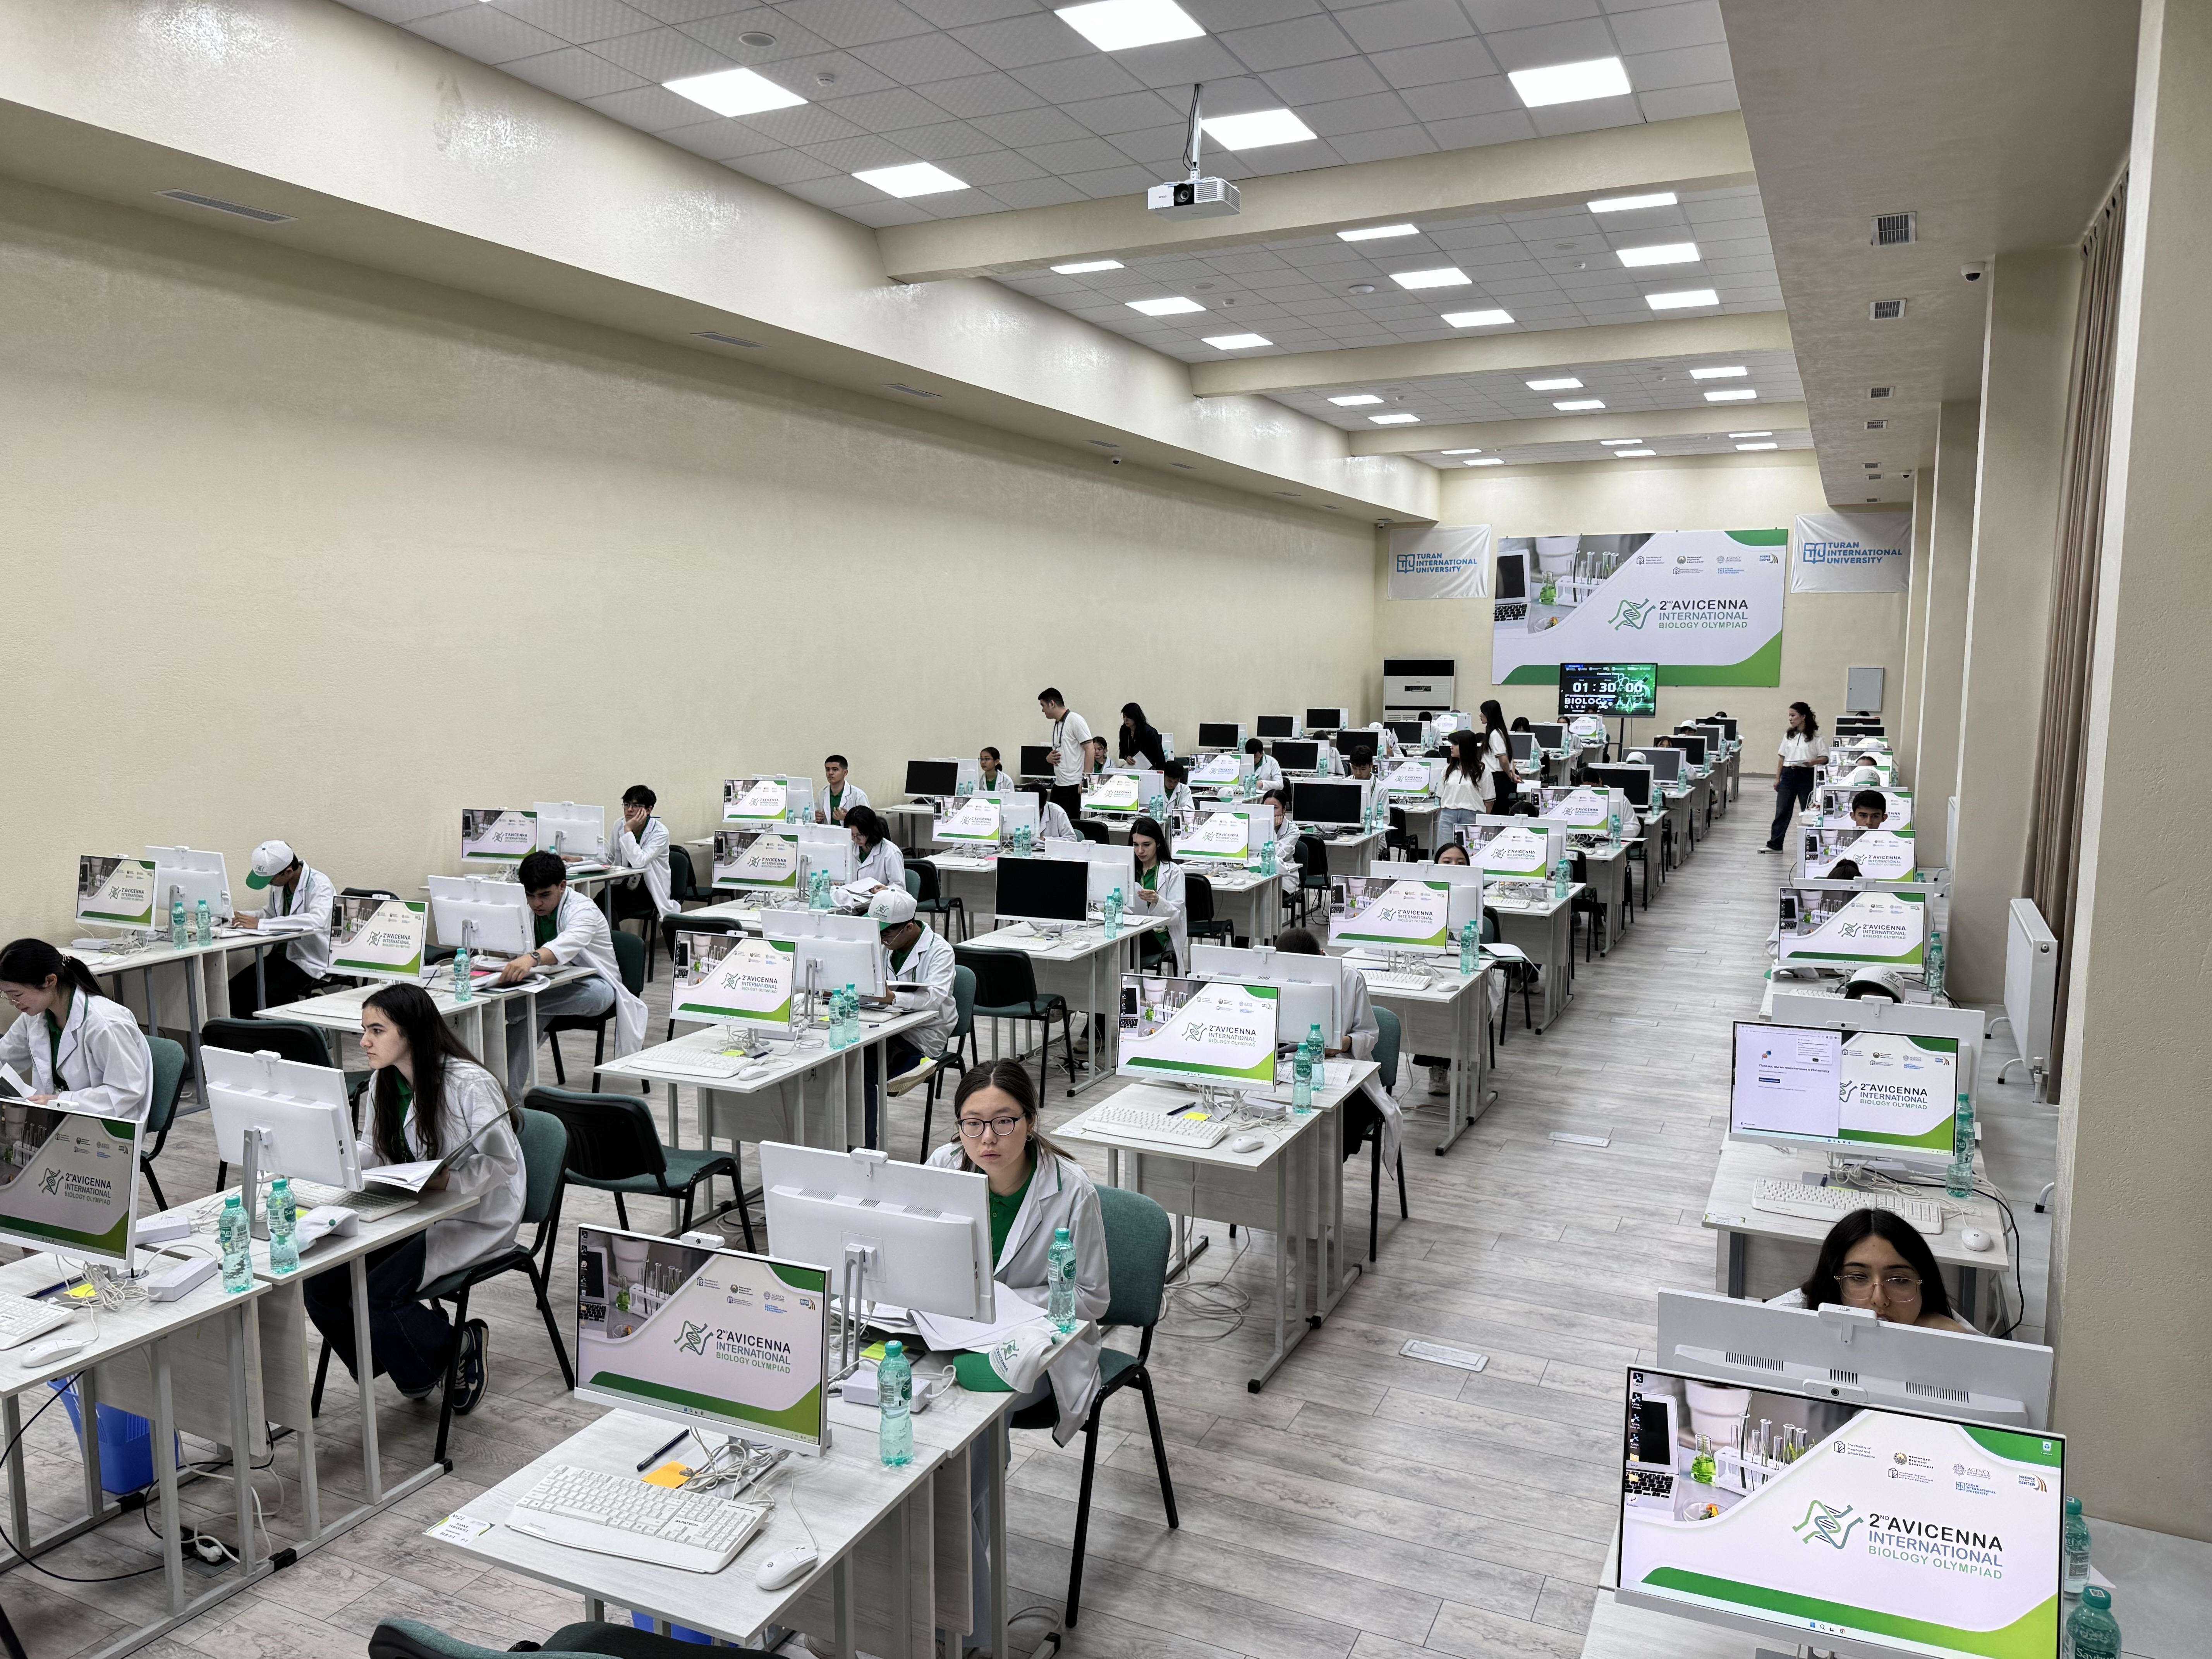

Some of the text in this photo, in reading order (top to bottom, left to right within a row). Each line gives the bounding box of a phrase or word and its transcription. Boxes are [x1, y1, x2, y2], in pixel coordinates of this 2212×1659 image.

[1672, 600, 1748, 610] AVICENNA
[1659, 612, 1748, 620] INTERNATIONAL
[747, 975, 777, 984] AVICENNA
[1209, 1032, 1256, 1042] INTERNATIONAL
[1216, 1026, 1256, 1036] AVICENNA
[1870, 1084, 1927, 1096] AVICENNA
[1860, 1092, 1927, 1104] INTERNATIONAL
[71, 1174, 112, 1190] AVICENNA
[65, 1183, 111, 1198] INTERNATIONAL
[64, 1191, 110, 1205] BIOLOGY OLYMPIAD
[727, 1331, 790, 1354] AVICENNA
[716, 1341, 791, 1365] INTERNATIONAL
[716, 1352, 790, 1374] BIOLOGY OLYMPIAD
[1869, 1513, 2002, 1552] 2ND AVICENNA
[1869, 1530, 2003, 1567] INTERNATIONAL
[1869, 1545, 2002, 1579] BIOLOGY OLYMPIAD
